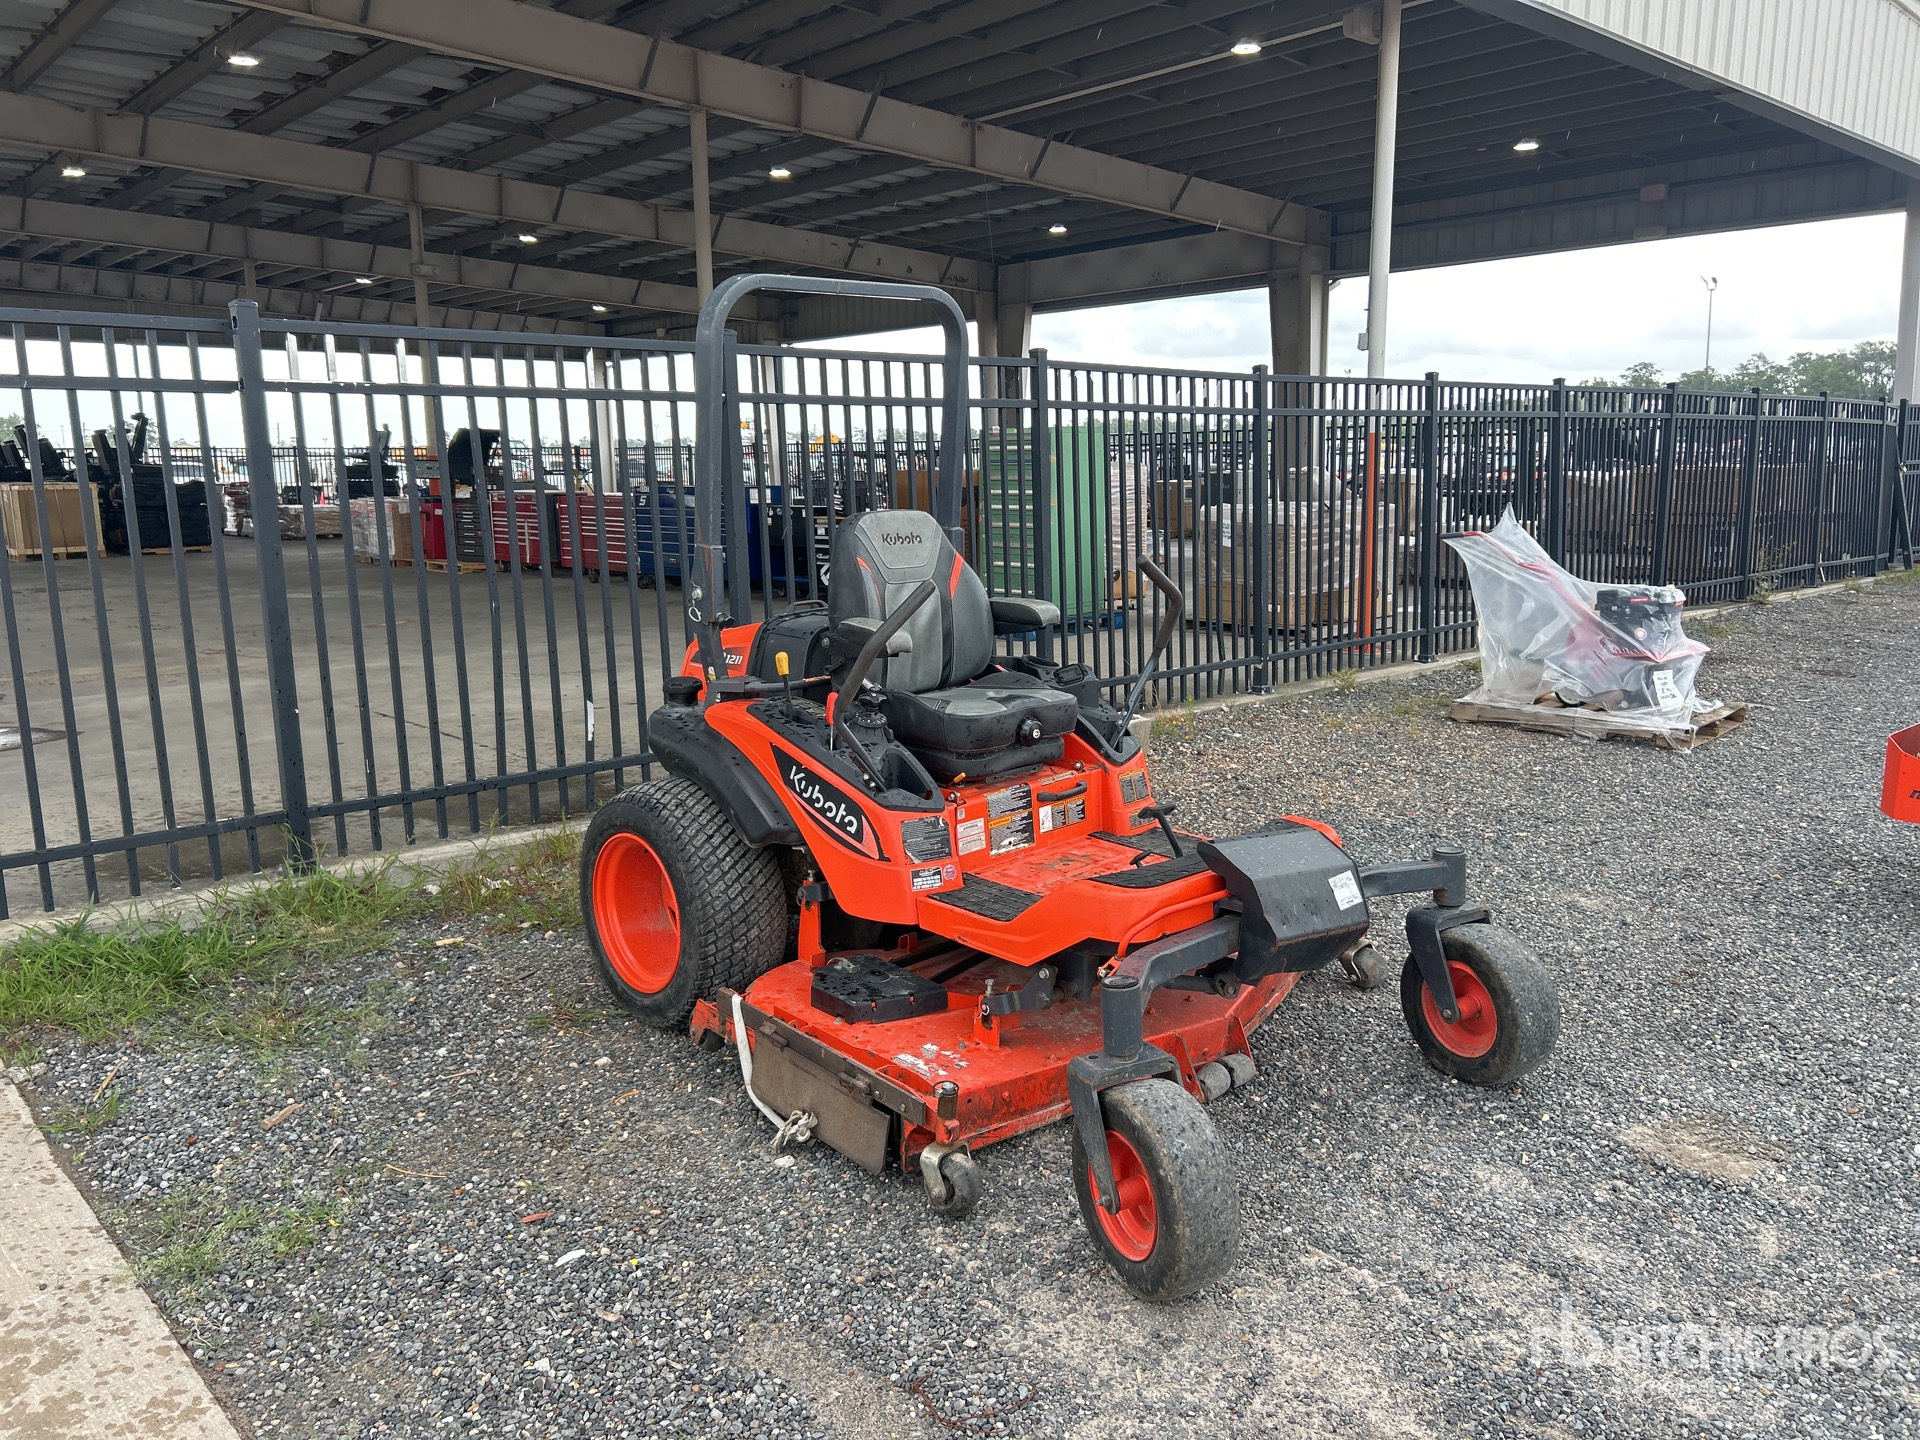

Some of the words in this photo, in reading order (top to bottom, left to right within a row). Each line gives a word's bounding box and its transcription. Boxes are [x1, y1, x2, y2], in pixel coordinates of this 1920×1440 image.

[881, 532, 923, 546] Kubota
[723, 651, 744, 666] 1211
[789, 765, 858, 834] Kubota
